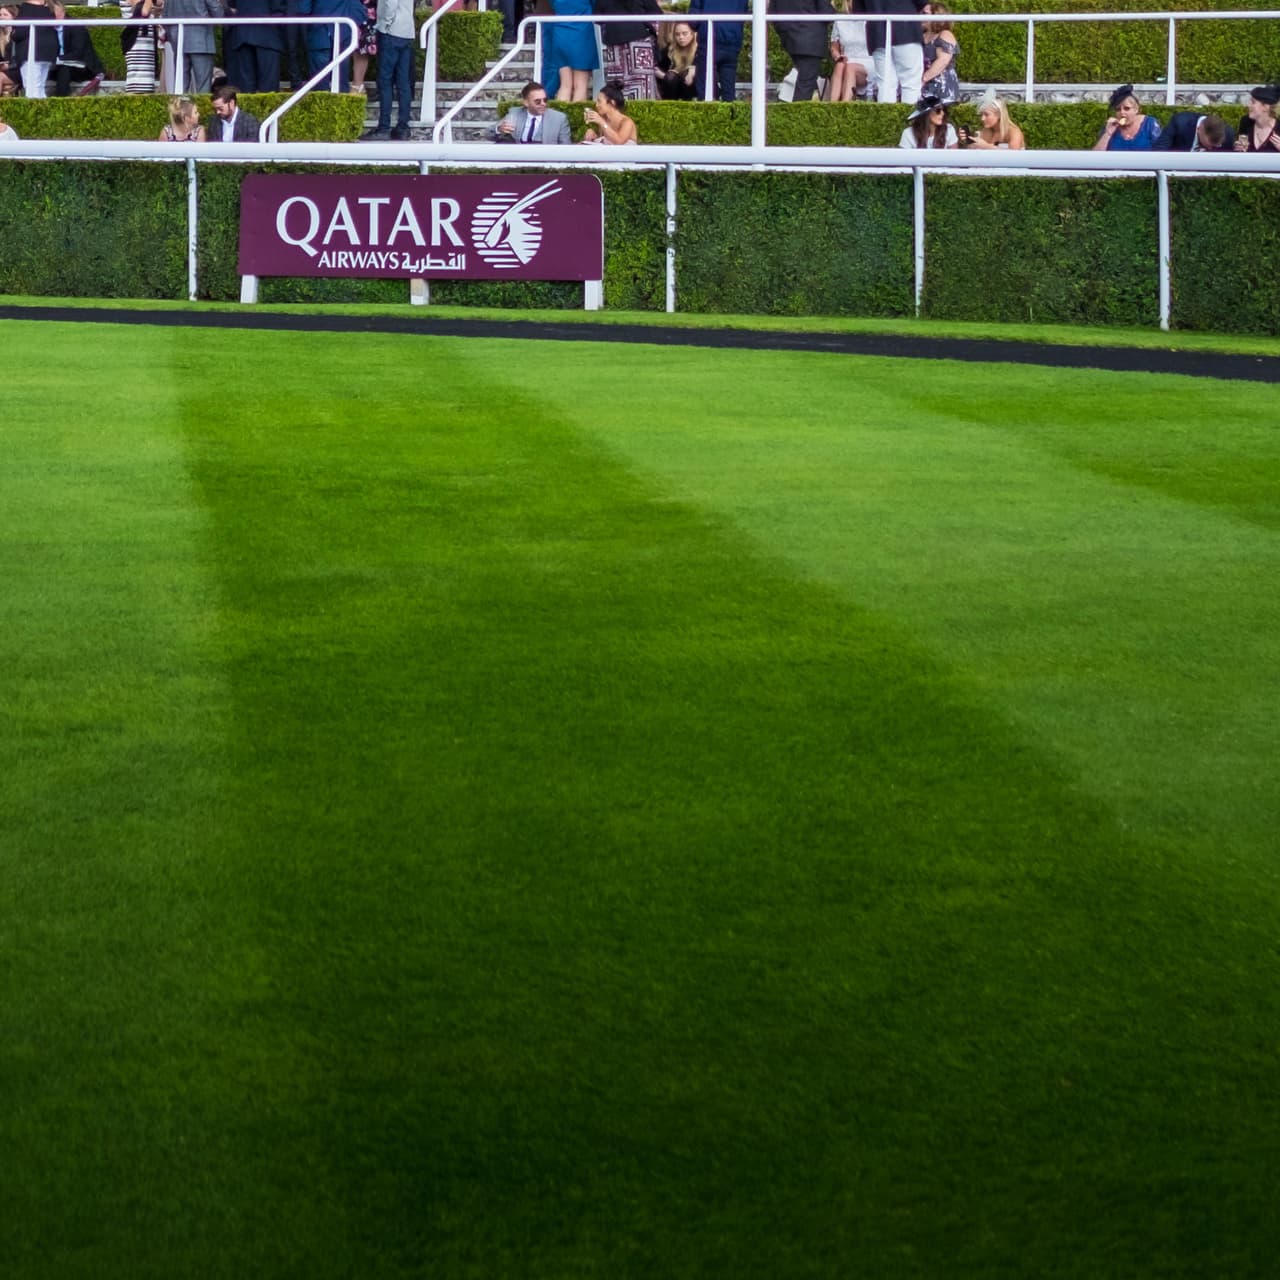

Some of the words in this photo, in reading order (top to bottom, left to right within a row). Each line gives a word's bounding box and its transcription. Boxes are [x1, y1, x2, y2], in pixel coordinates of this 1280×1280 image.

[276, 196, 466, 258] QATAR
[317, 250, 400, 270] AIRWAYS
[401, 251, 467, 274] القطرية
